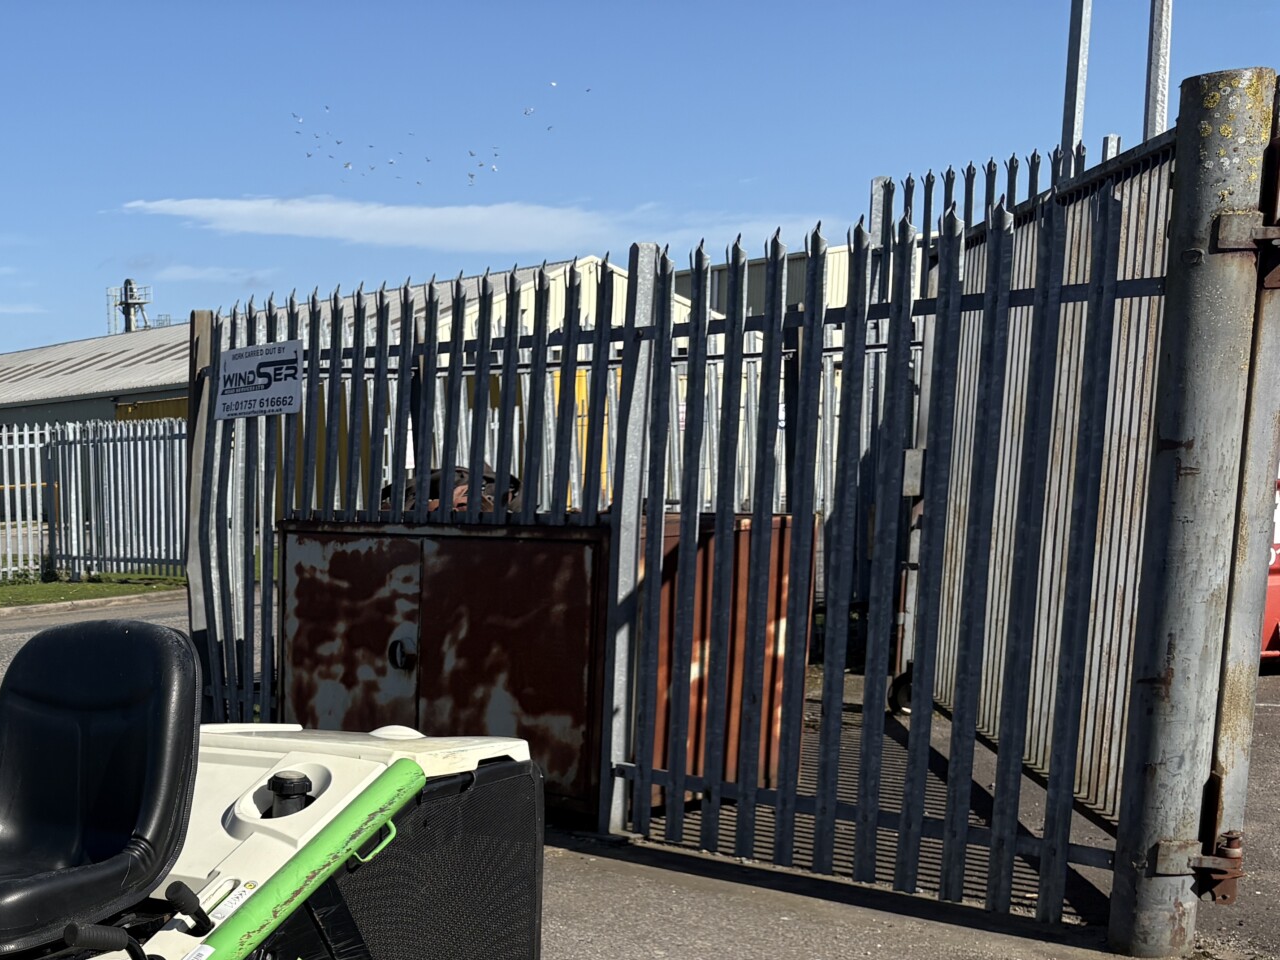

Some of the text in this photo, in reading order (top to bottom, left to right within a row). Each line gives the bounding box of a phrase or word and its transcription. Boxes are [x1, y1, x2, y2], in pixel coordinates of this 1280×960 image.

[231, 346, 285, 361] WORK CARRIED OUT BY
[223, 359, 298, 389] WINDSER
[222, 396, 294, 412] Tel:01757 616662
